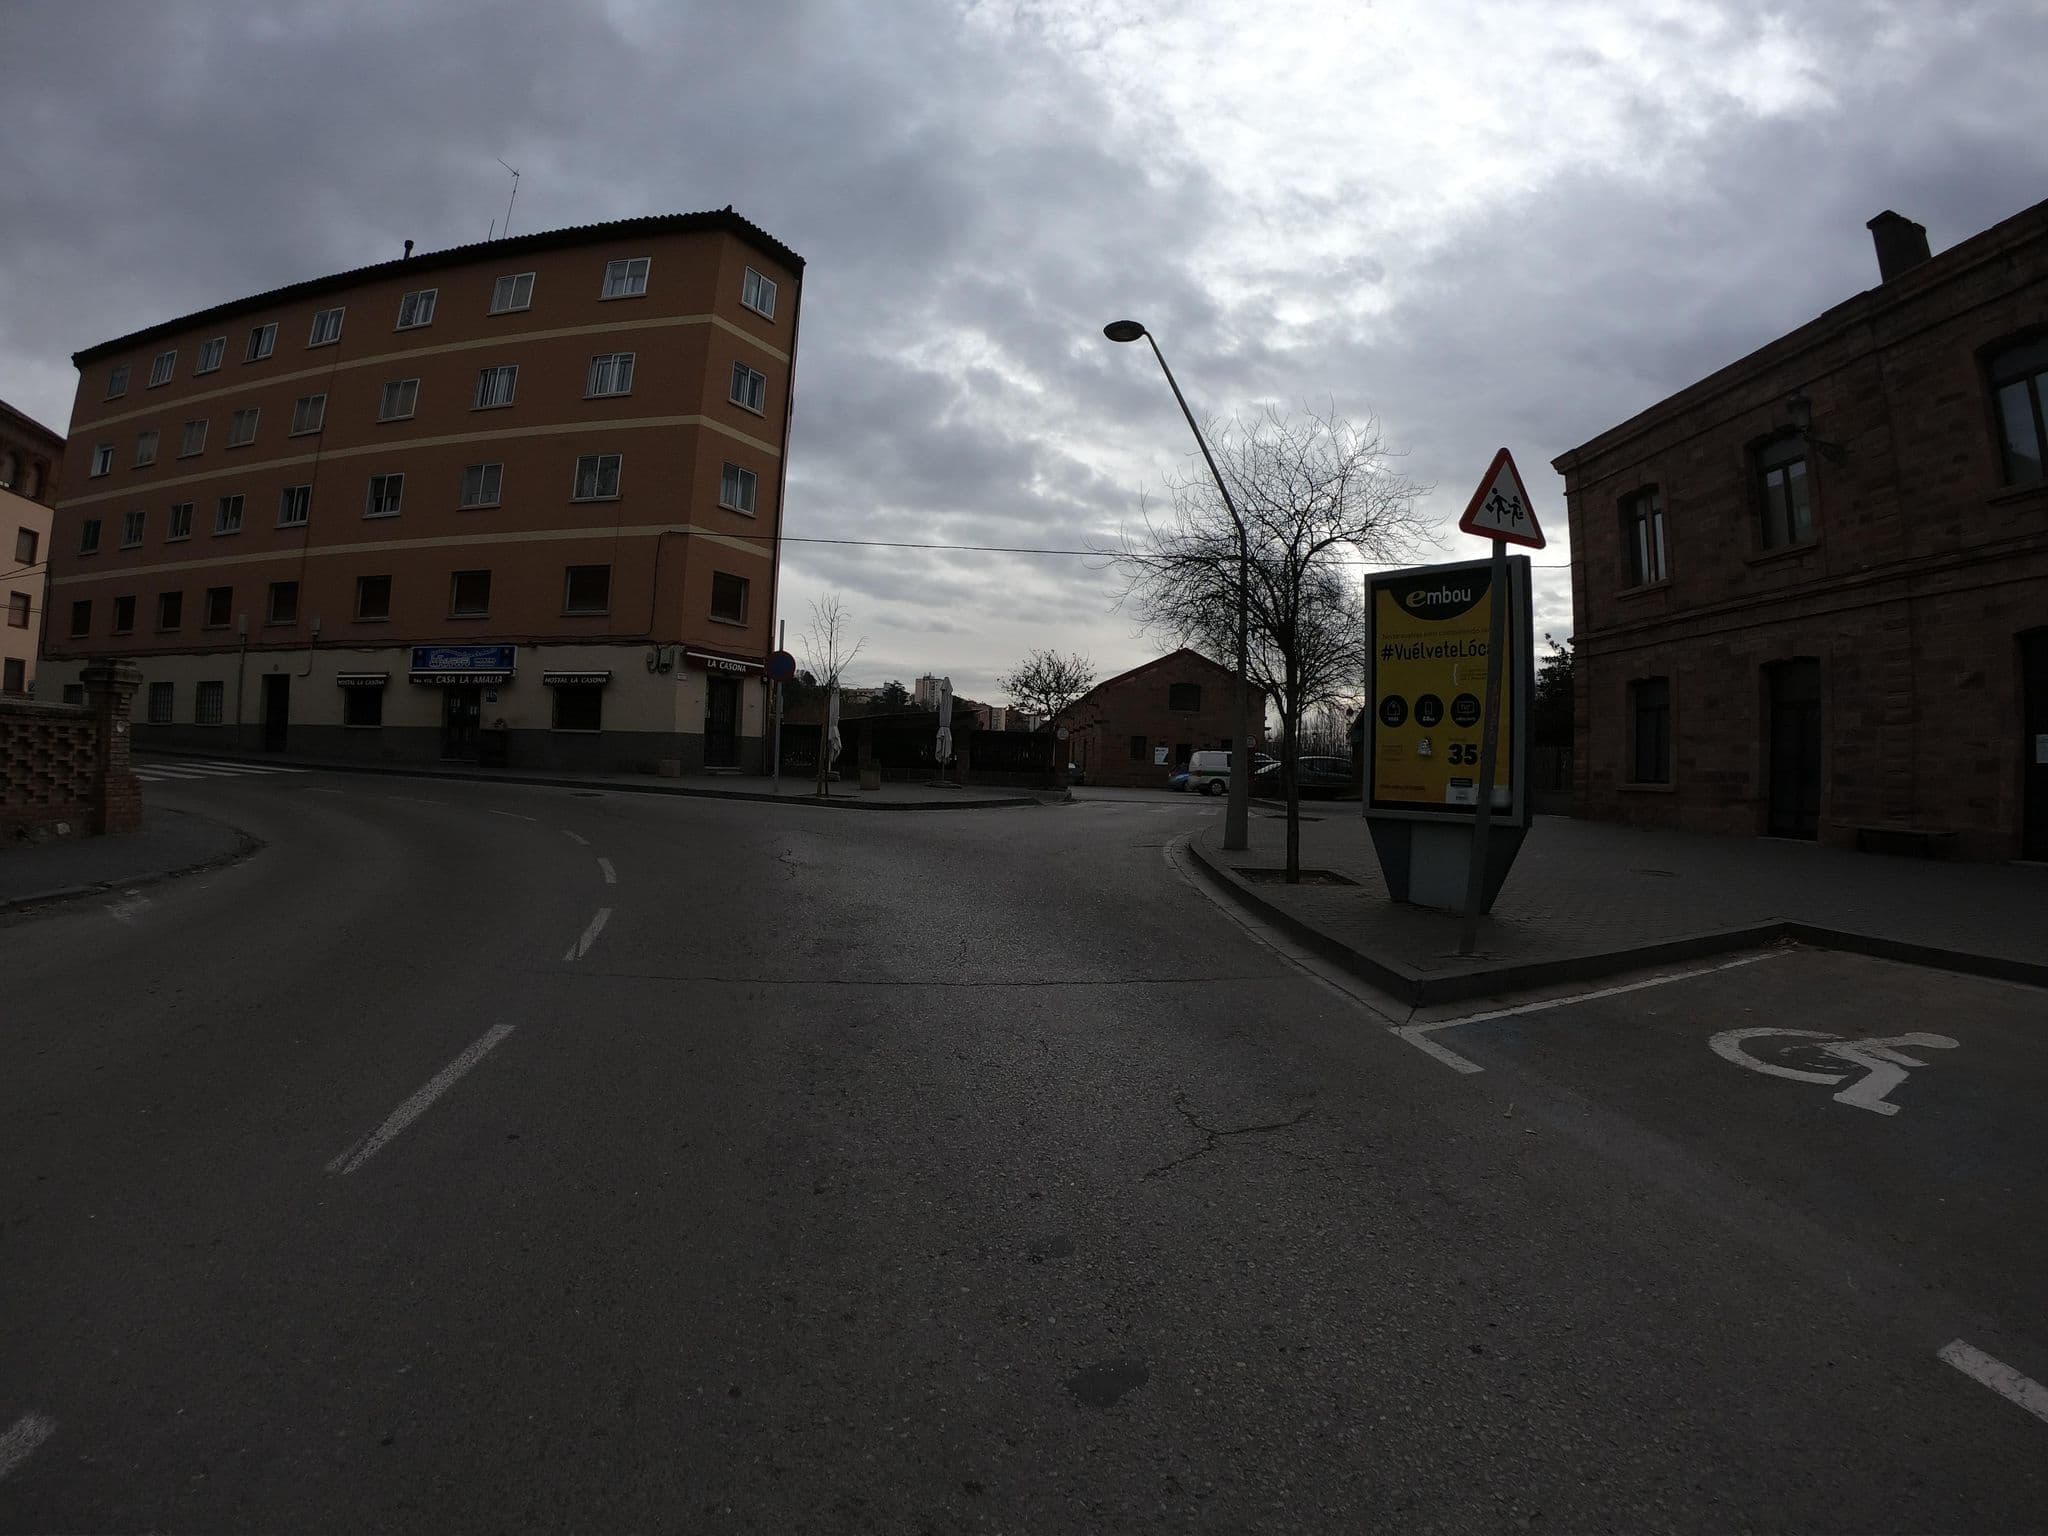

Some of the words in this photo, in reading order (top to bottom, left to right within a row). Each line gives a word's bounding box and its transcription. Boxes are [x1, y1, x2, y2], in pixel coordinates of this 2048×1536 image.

[1406, 586, 1471, 608] embou
[707, 659, 716, 668] LA
[719, 661, 746, 672] CASONA
[436, 675, 456, 684] CASA
[459, 675, 469, 684] LA
[472, 675, 503, 684] AMALIA
[1448, 743, 1478, 765] 35
